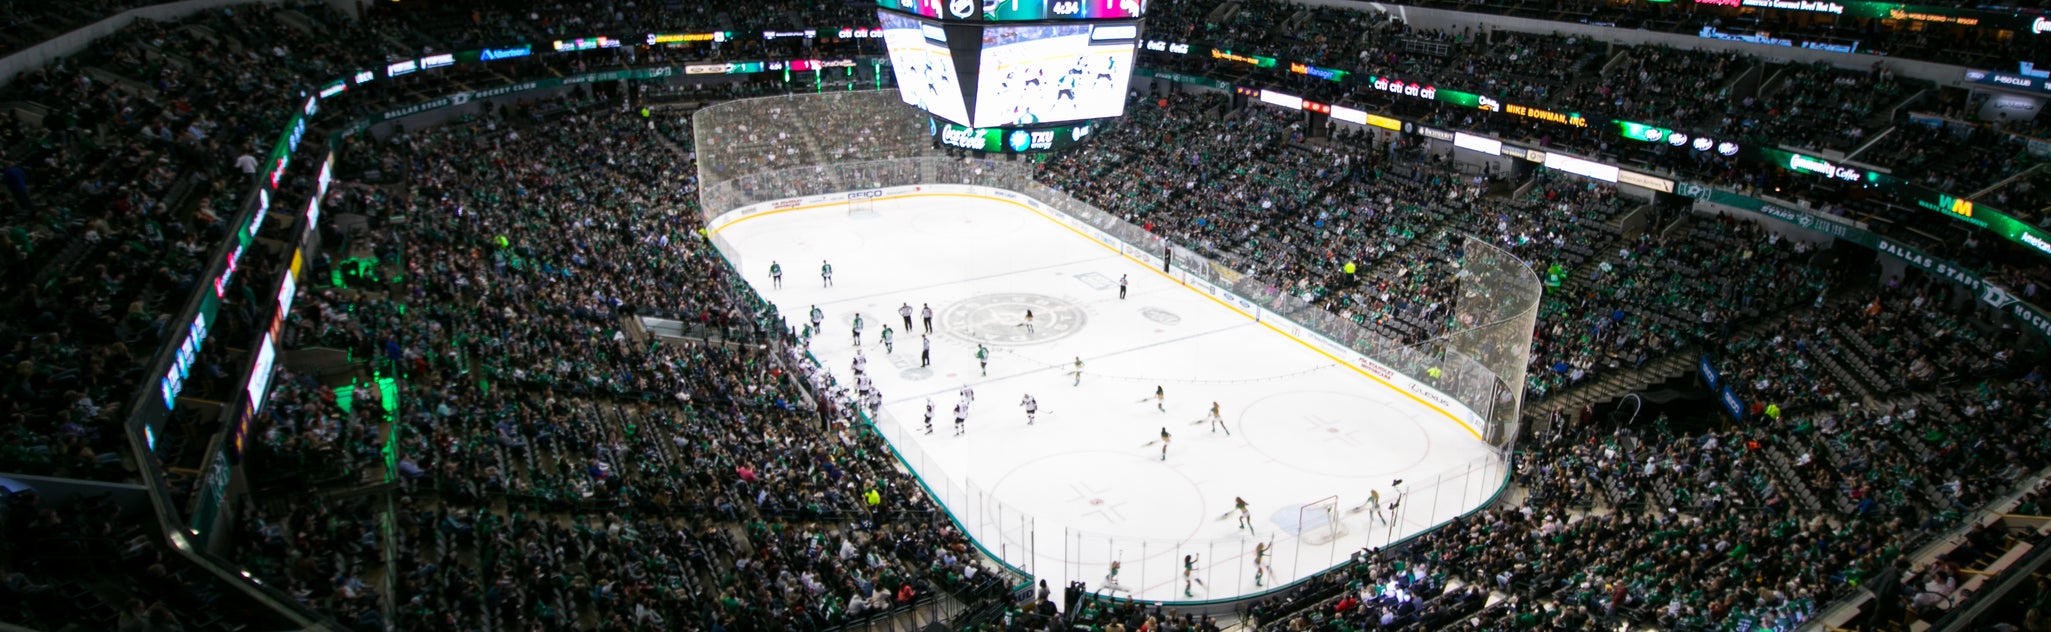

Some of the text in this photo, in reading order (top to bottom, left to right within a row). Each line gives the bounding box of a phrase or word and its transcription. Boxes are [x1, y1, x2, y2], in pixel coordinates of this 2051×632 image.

[1053, 1, 1079, 14] 4:34
[1800, 0, 1815, 10] Beef
[1815, 1, 1829, 11] Hot
[1829, 2, 1844, 14] Dog
[1374, 80, 1436, 100] citi citi citi citi
[1506, 103, 1588, 128] MIKE BOWMAN, INC.
[1031, 131, 1054, 144] TXU
[1031, 142, 1052, 150] energy
[1790, 154, 1861, 181] Community Coffee
[848, 190, 882, 200] GEICO
[1918, 200, 1988, 228] WASTE MANAGEMENT
[1939, 194, 1973, 217] WM
[1879, 241, 1933, 268] DALLAS
[1936, 263, 1980, 290] STARS
